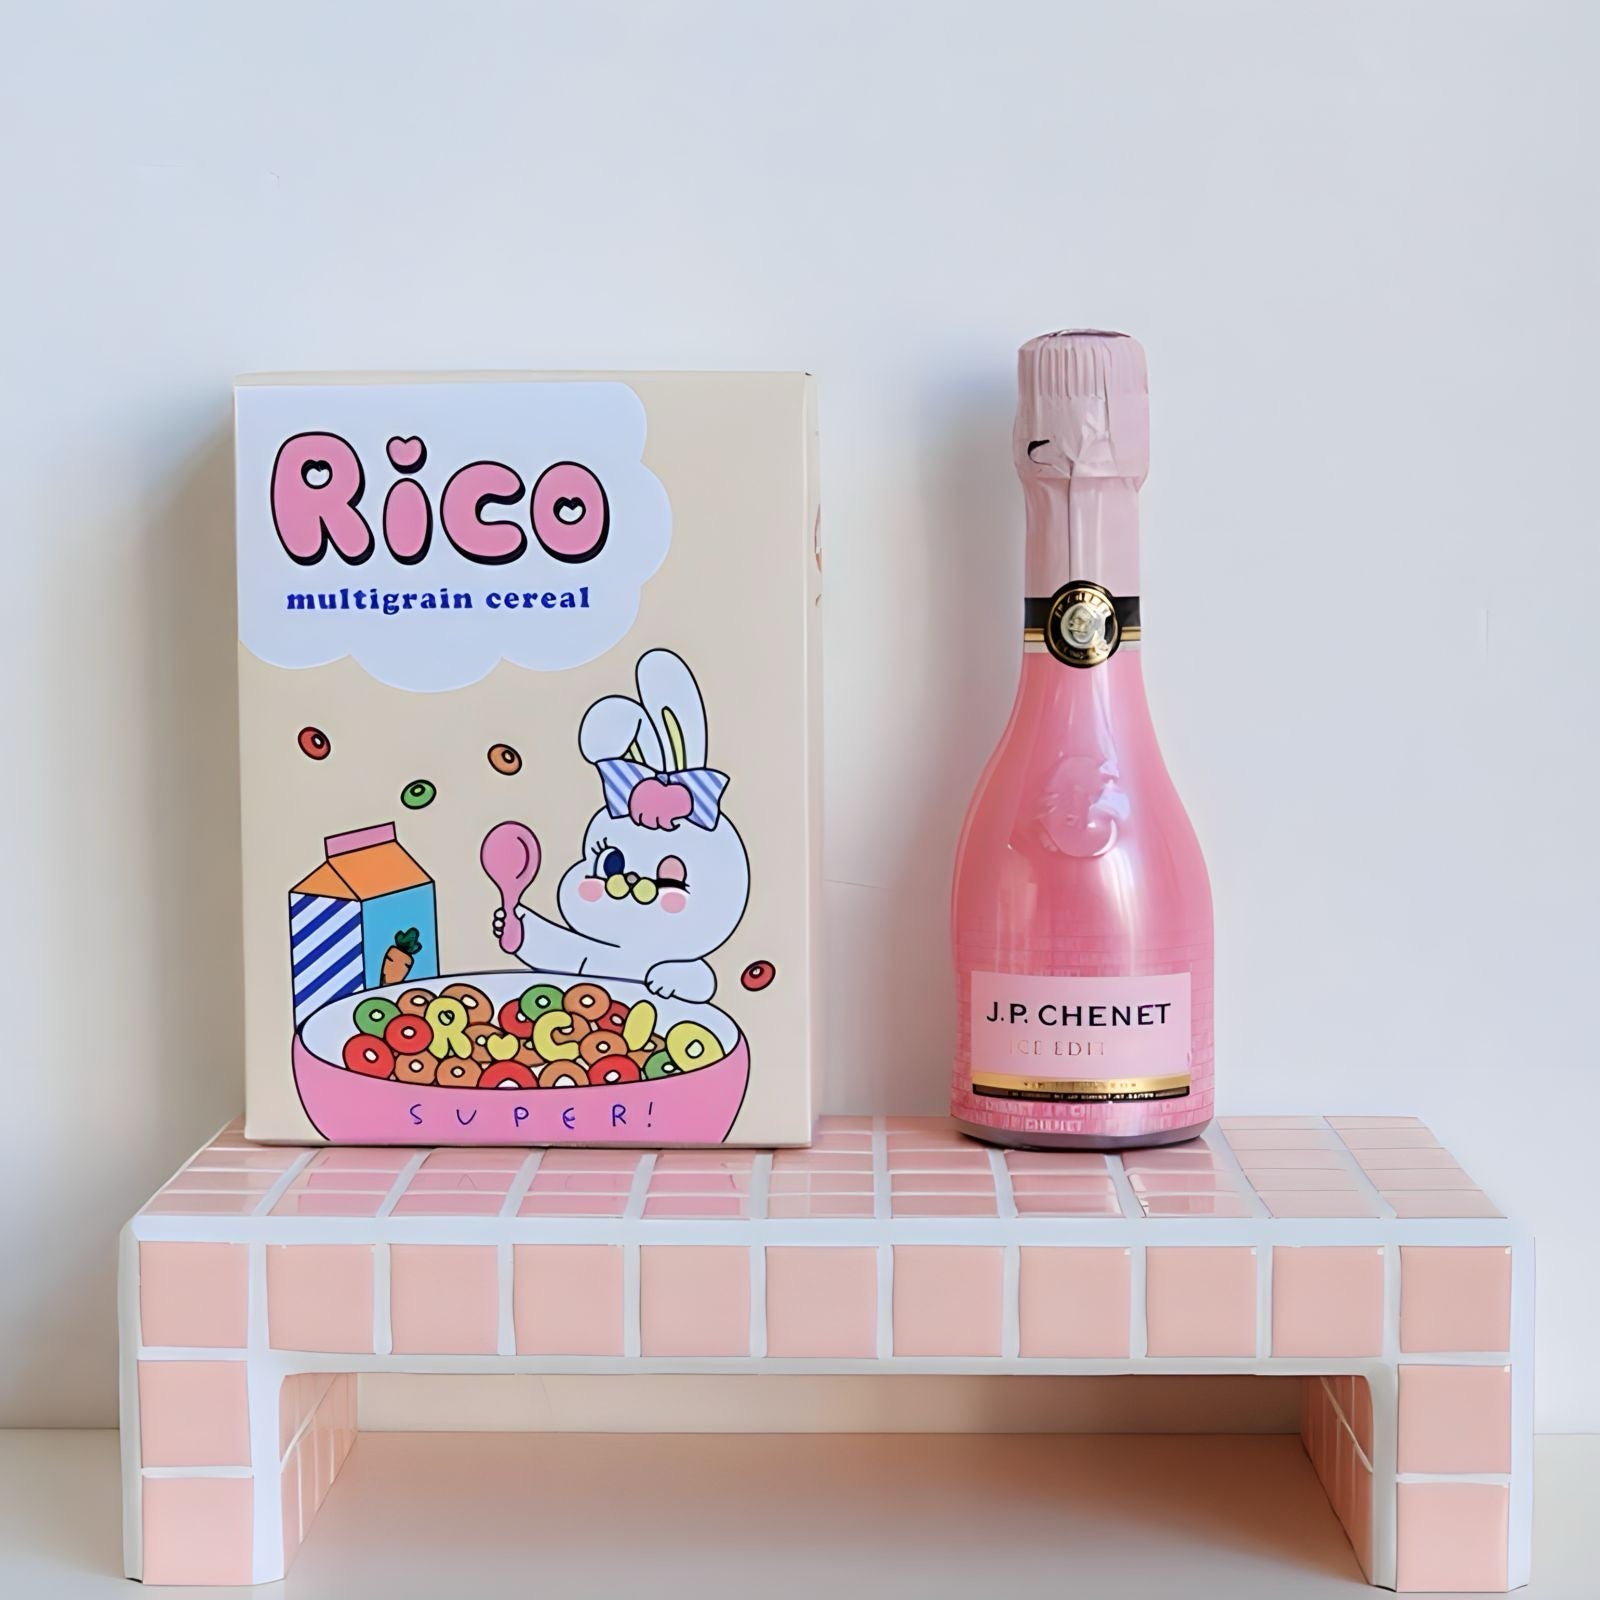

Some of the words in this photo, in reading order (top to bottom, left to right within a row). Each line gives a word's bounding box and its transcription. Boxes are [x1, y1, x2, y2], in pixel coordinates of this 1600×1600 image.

[270, 431, 610, 566] Rico
[286, 587, 473, 615] multigrain
[486, 586, 590, 609] cereal
[986, 1001, 1028, 1024] J.P.
[1038, 1003, 1171, 1027] CHENET
